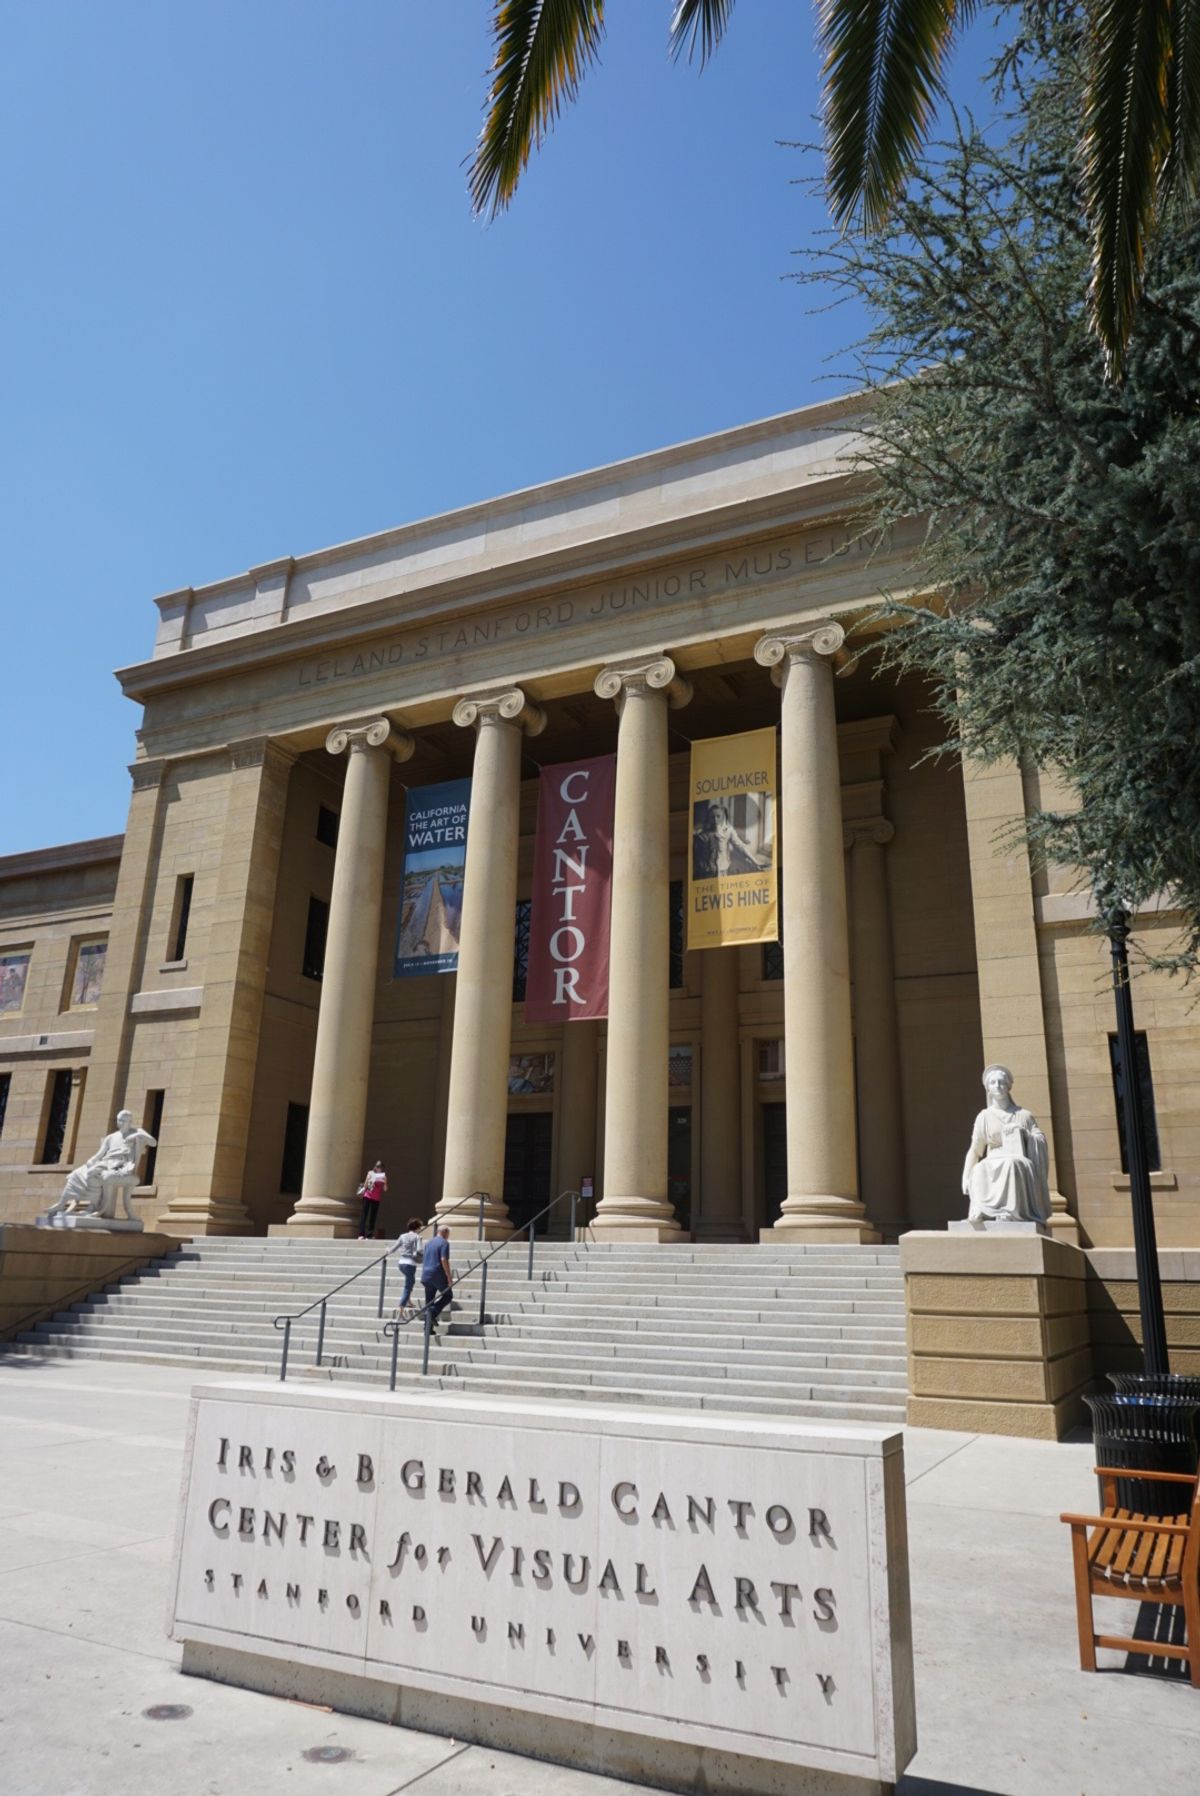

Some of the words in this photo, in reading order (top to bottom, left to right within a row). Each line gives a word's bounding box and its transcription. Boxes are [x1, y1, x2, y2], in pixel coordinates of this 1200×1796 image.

[299, 643, 403, 686] LELAND
[416, 602, 573, 657] STANFORD
[590, 569, 706, 614] JUNIOR
[724, 530, 884, 583] MUSEUM
[696, 771, 769, 795] SOULMAKER
[410, 804, 467, 822] CALIFORNIA
[410, 821, 428, 832] THE
[430, 817, 450, 829] ART
[452, 815, 467, 824] OF
[409, 826, 465, 848] WATER
[550, 771, 588, 1005] CANTOR
[696, 884, 714, 895] THE
[720, 881, 750, 891] TIMES
[755, 878, 769, 887] OF
[695, 892, 734, 913] LEWIS
[738, 888, 770, 908] HINE
[217, 1437, 295, 1474] IRIS
[316, 1455, 336, 1478] &
[356, 1453, 374, 1483] B
[401, 1459, 580, 1508] GERALD
[611, 1481, 834, 1542] CANTOR
[208, 1498, 370, 1553] CENTER
[387, 1531, 449, 1569] for
[470, 1533, 656, 1596] VISUAL
[687, 1563, 836, 1622] ARTS
[204, 1569, 426, 1622] STANFORD
[471, 1615, 833, 1694] UNIVERSITY
